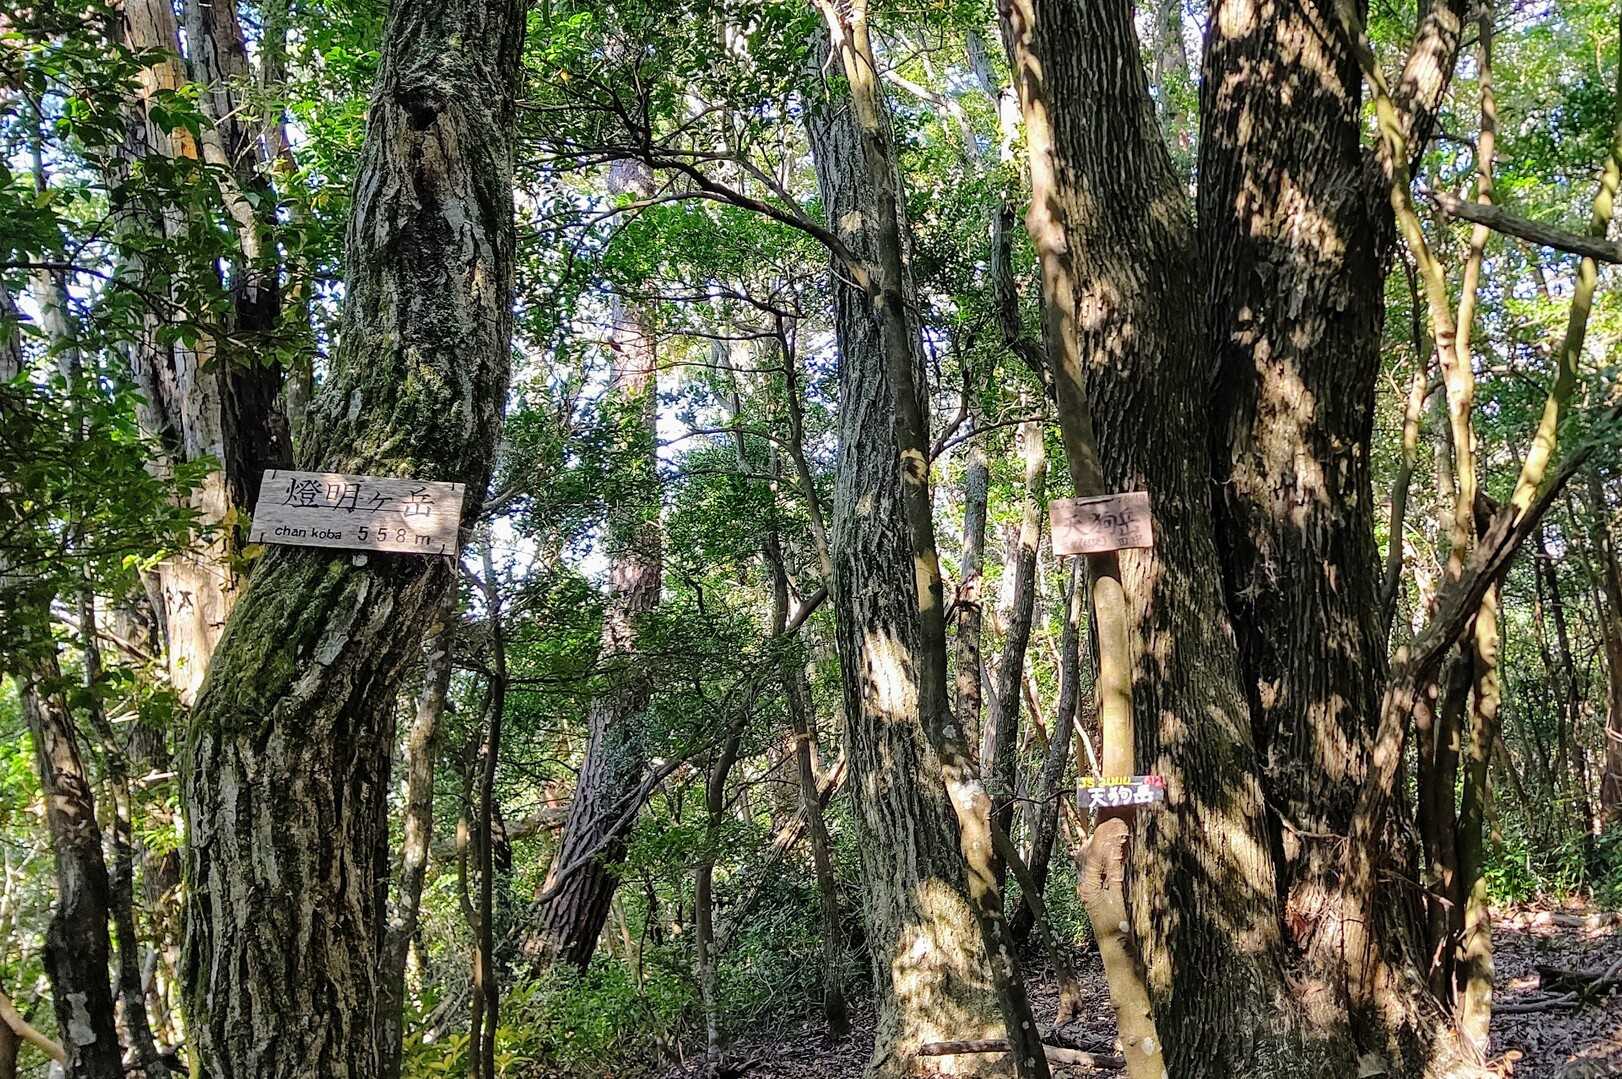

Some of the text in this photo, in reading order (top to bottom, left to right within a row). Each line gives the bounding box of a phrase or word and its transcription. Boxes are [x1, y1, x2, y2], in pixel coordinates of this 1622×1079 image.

[275, 525, 306, 538] chan
[311, 528, 342, 540] koba
[1087, 784, 1154, 808] 天狗岳
